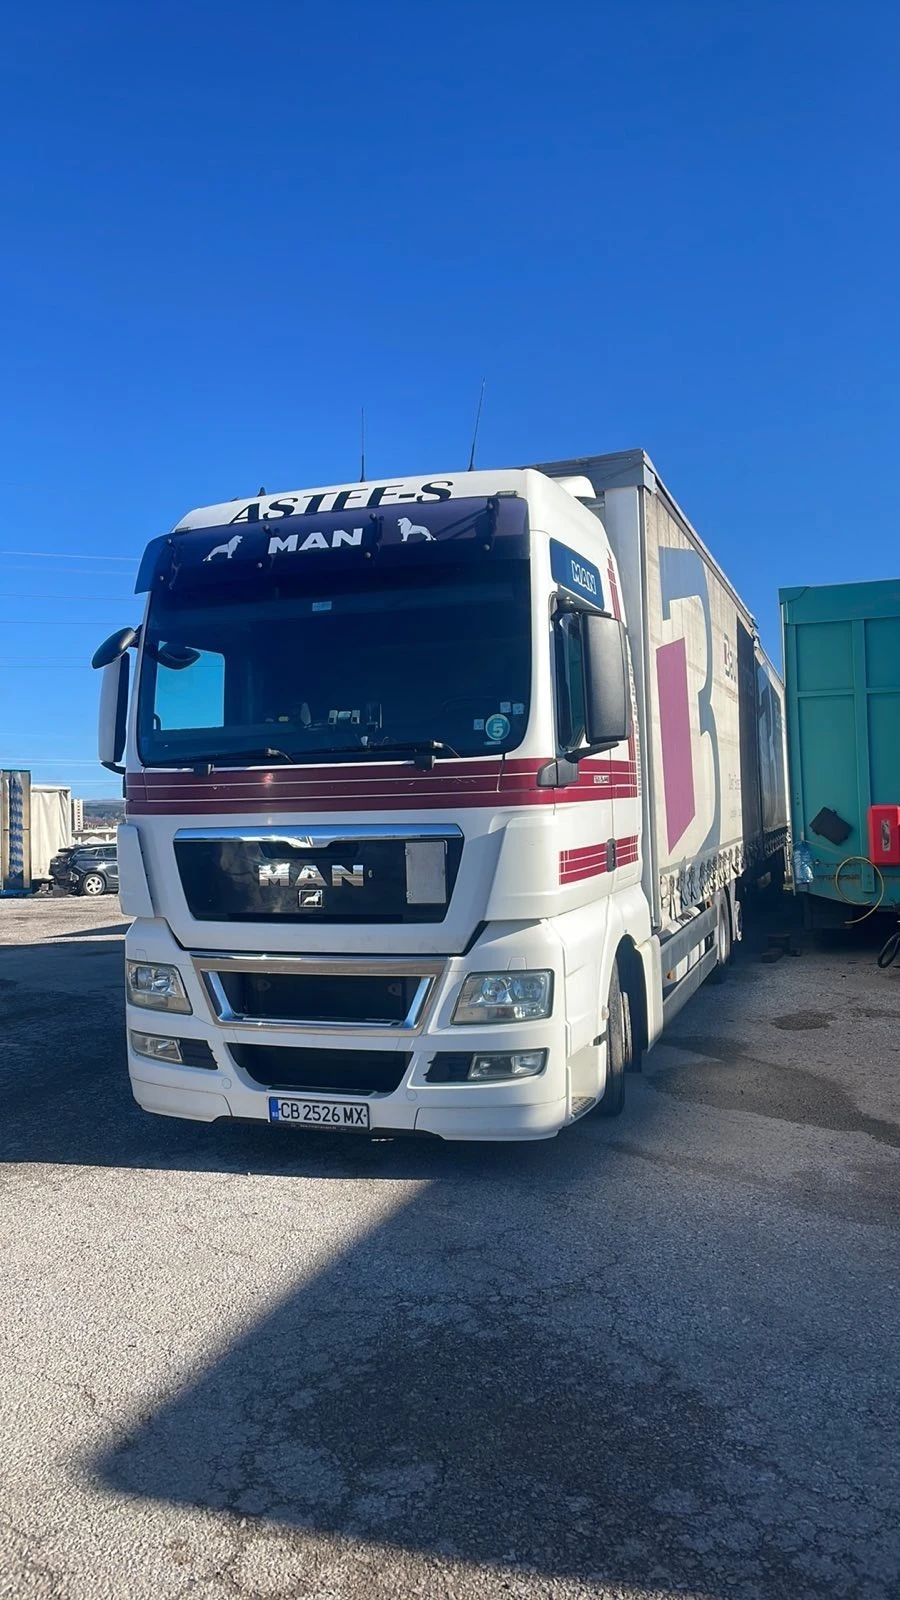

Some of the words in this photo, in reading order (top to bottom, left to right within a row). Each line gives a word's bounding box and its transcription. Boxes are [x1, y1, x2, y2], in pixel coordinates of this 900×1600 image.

[267, 528, 363, 554] MAN
[571, 560, 596, 595] MAN
[492, 723, 504, 737] 5
[258, 863, 364, 887] MAN
[281, 1102, 300, 1120] CB
[303, 1104, 341, 1122] 2526
[343, 1107, 364, 1124] MX
